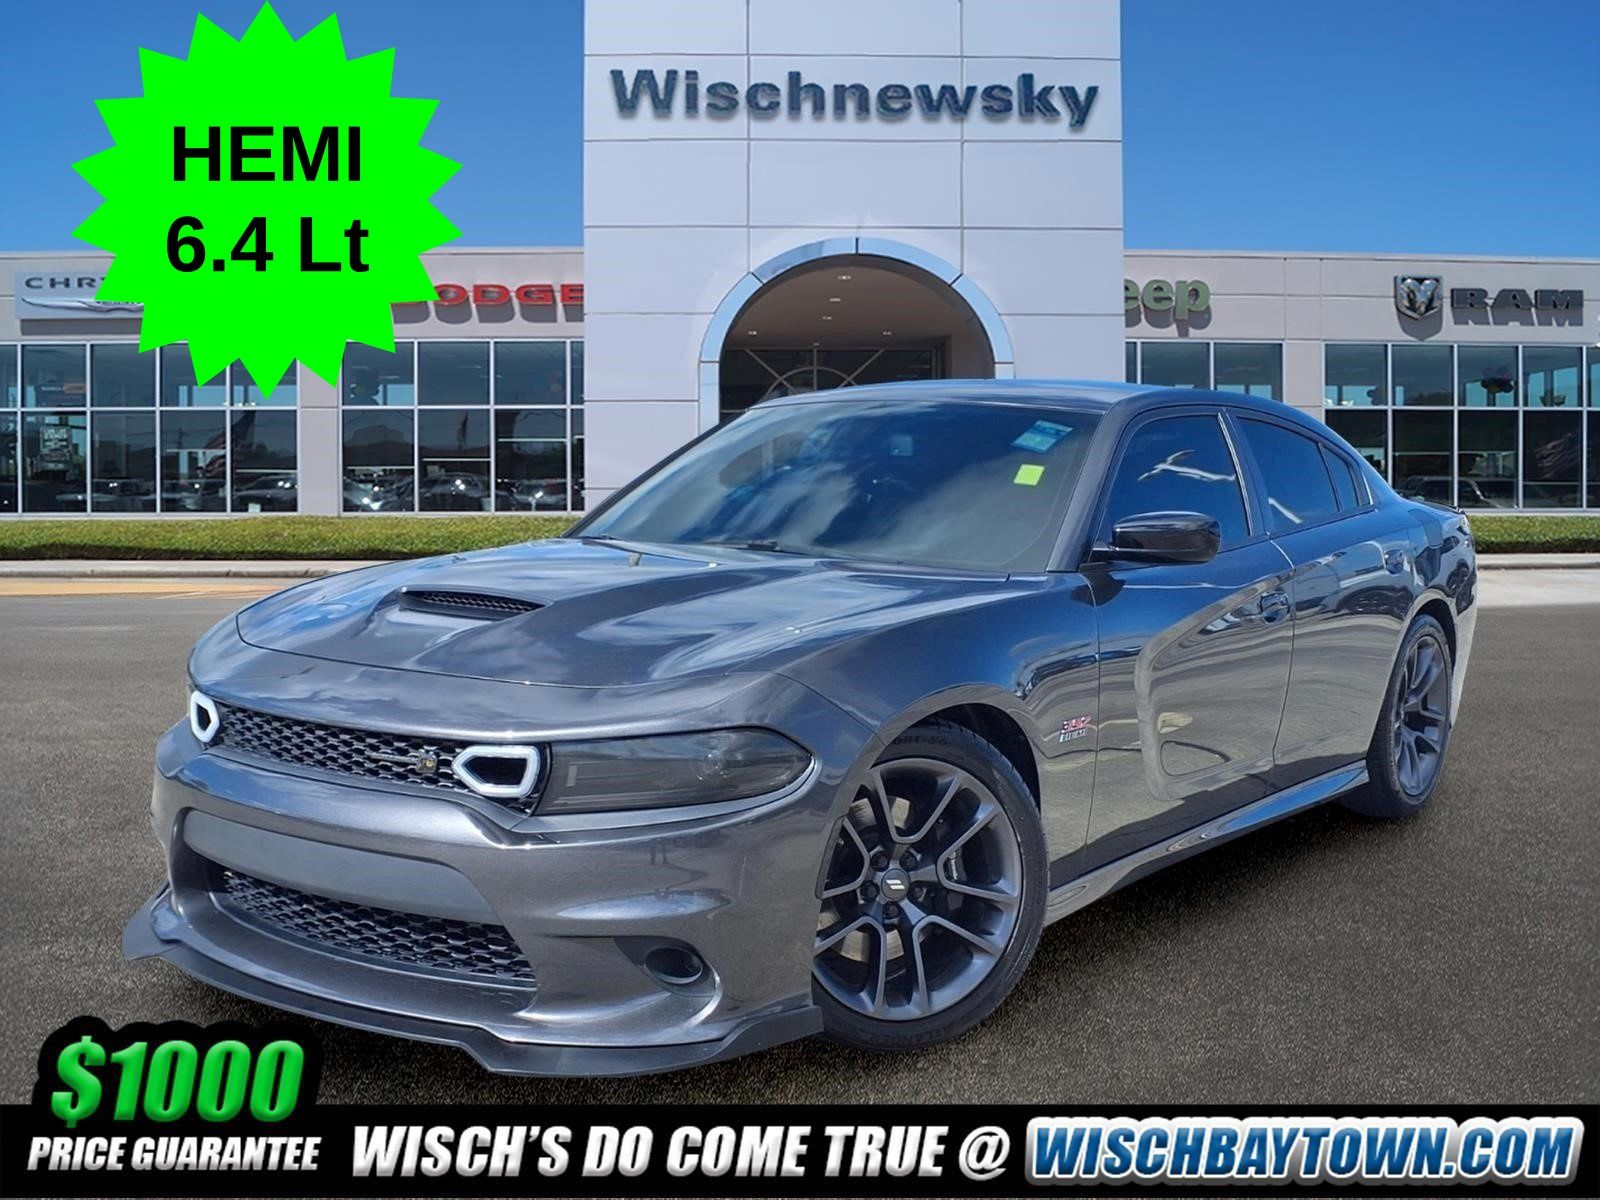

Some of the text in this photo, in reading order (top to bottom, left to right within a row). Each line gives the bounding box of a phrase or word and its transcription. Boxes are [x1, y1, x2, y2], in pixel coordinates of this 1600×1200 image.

[609, 69, 1099, 129] Wischnewsky
[25, 276, 105, 289] CHR
[391, 283, 584, 305] ODGE
[1124, 278, 1211, 320] eep
[1451, 288, 1584, 309] RAM
